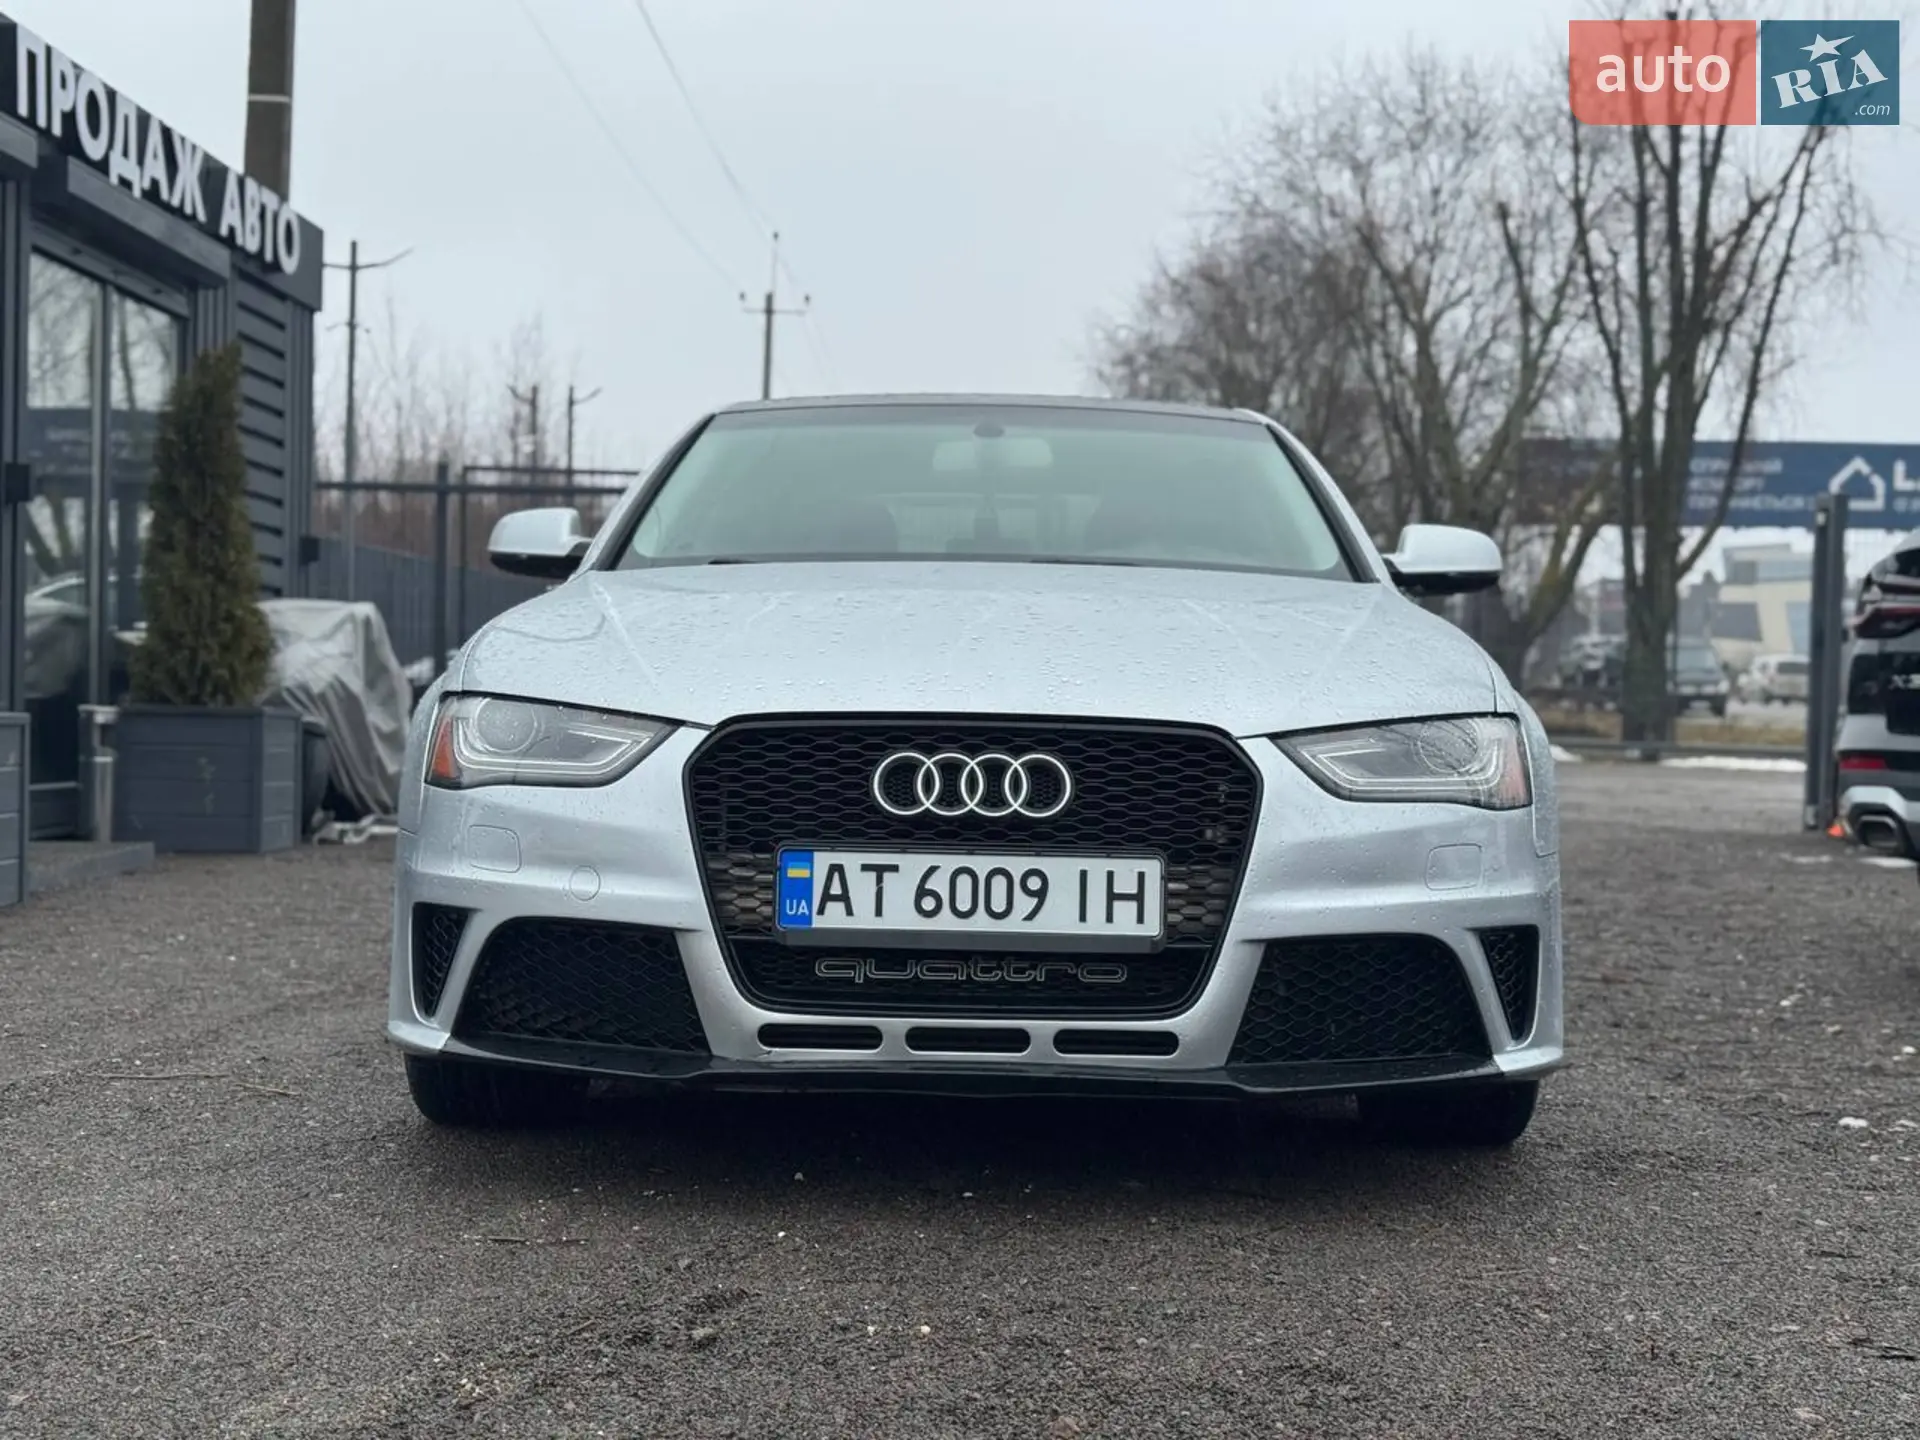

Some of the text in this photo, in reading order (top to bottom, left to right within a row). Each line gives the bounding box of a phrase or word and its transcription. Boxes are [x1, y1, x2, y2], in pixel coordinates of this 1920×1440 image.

[16, 23, 300, 275] ПРОДАЖ АВТО
[785, 899, 809, 916] UA
[816, 863, 1145, 925] AT 6009 IH
[815, 956, 1127, 984] quattro
